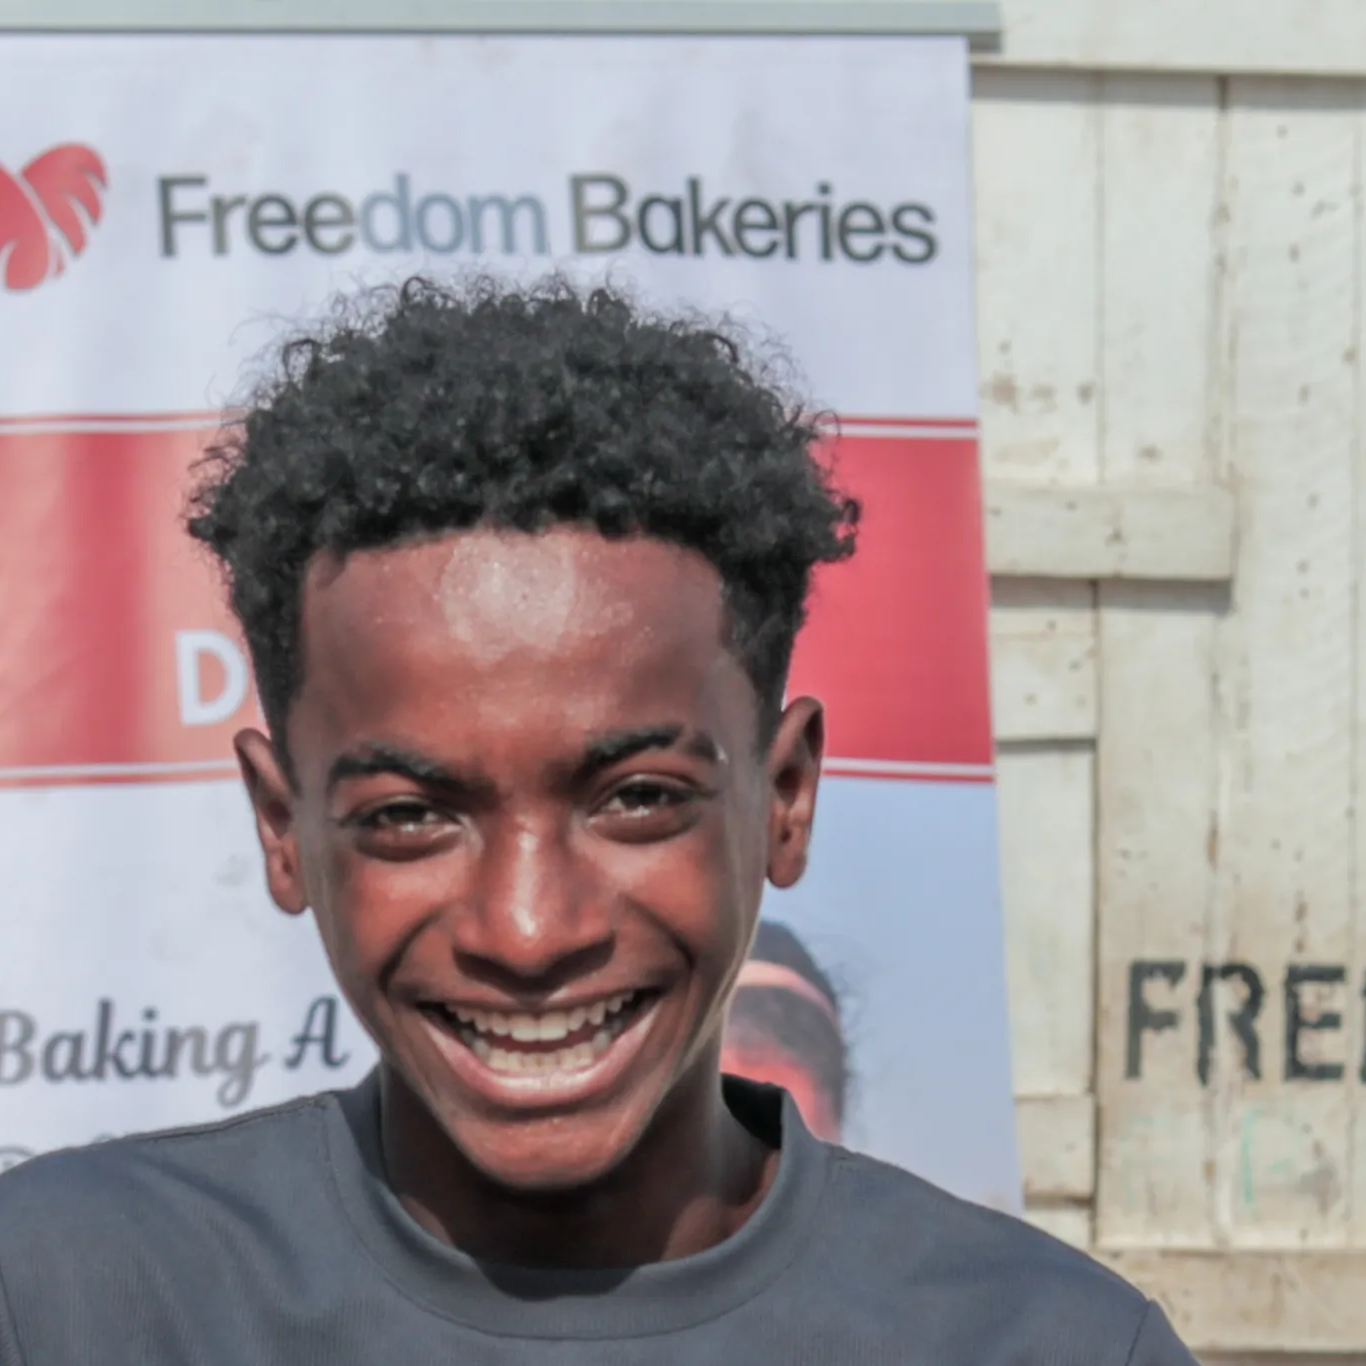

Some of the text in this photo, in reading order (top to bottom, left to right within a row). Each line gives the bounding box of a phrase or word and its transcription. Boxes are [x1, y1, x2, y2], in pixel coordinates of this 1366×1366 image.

[156, 172, 939, 266] Freedom Bakeries
[175, 629, 268, 727] D
